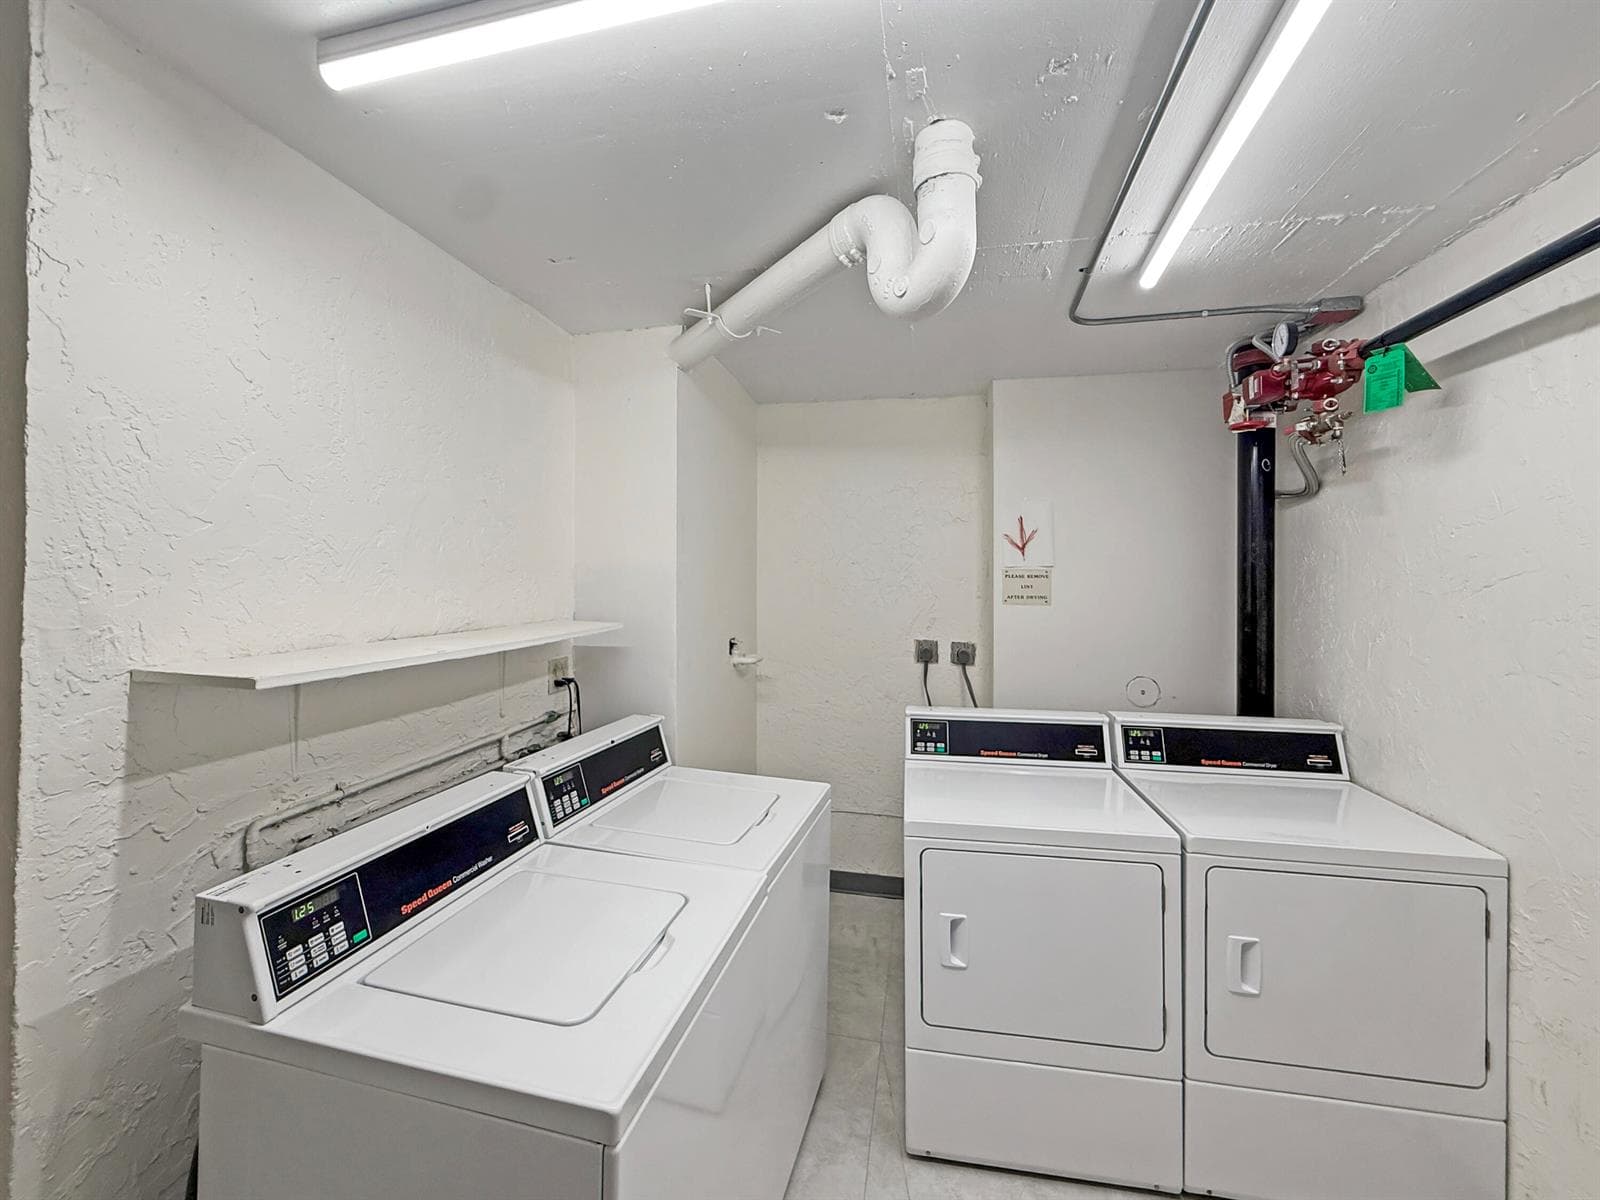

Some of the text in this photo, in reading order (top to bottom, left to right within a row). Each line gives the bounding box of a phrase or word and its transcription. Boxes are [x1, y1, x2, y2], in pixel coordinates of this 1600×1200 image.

[1221, 759, 1242, 767] Queen
[601, 782, 614, 794] Speed
[401, 856, 493, 915] Speed Queen Commercial Washer
